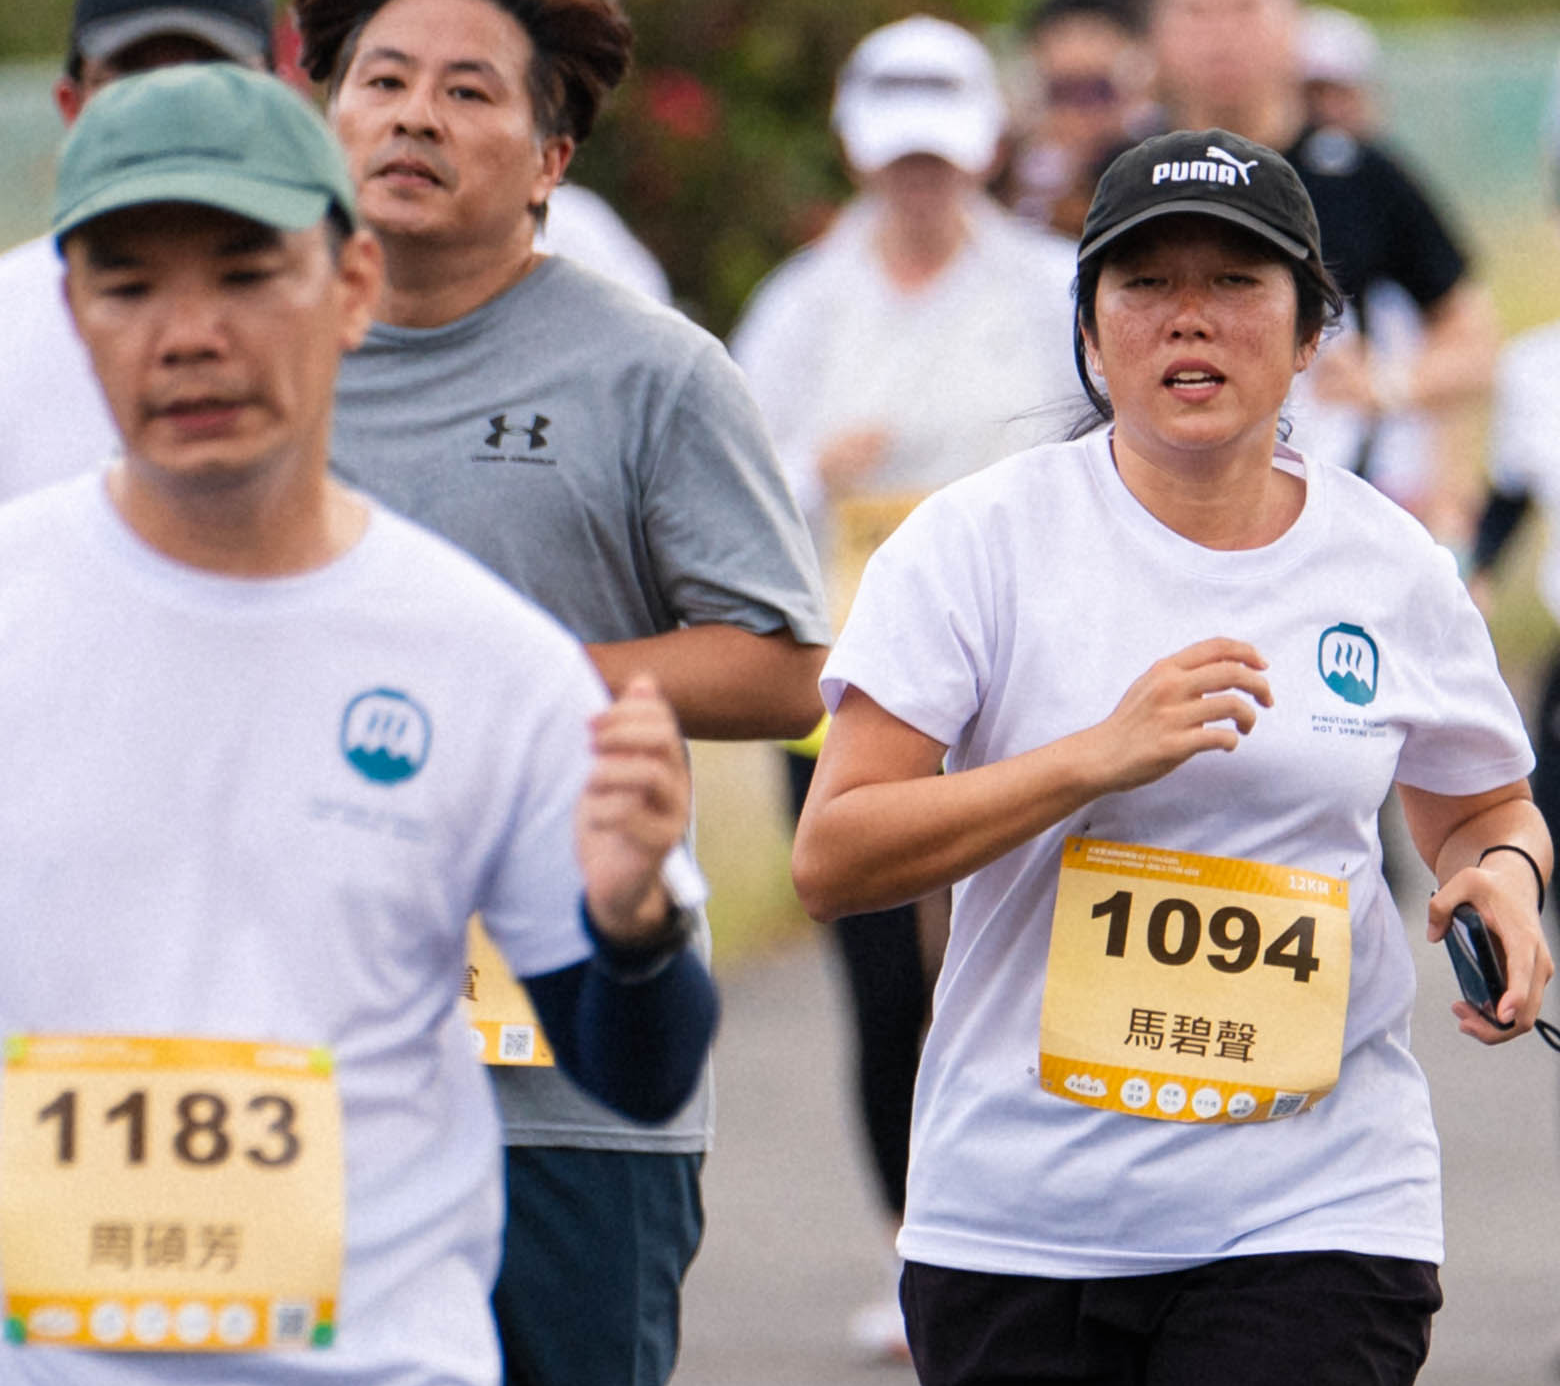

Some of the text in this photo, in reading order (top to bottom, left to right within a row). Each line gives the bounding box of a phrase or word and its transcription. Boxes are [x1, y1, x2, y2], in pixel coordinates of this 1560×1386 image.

[1152, 160, 1237, 186] PUMA
[1289, 874, 1330, 896] 12KM
[1090, 889, 1321, 984] 1094
[1124, 1007, 1258, 1063] 馬碧聲
[37, 1088, 303, 1171] 1183
